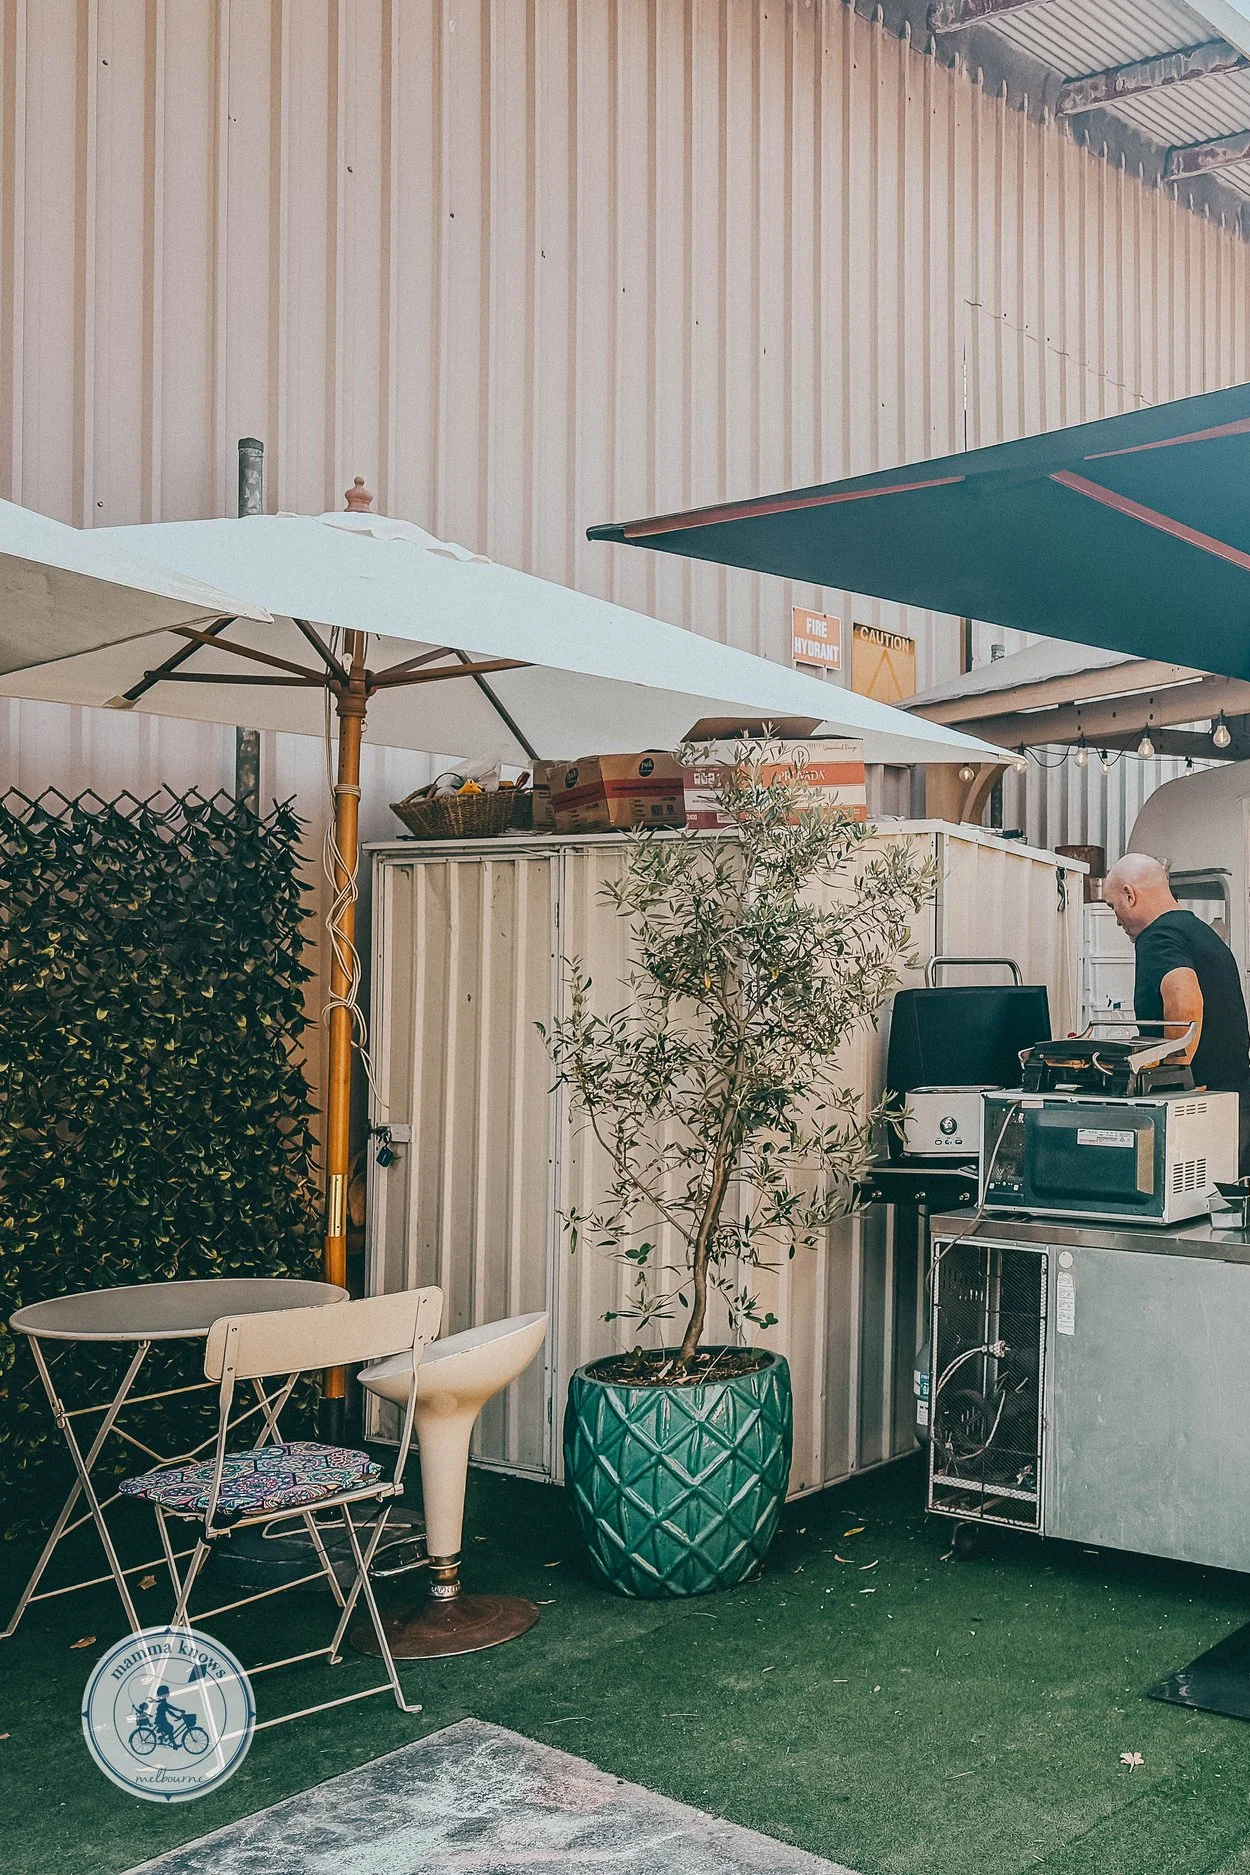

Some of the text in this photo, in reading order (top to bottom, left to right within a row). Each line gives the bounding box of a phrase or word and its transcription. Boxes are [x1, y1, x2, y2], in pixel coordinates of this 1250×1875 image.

[806, 617, 828, 638] FIRE
[859, 626, 910, 653] CAUTION
[794, 636, 839, 662] HYDRANT
